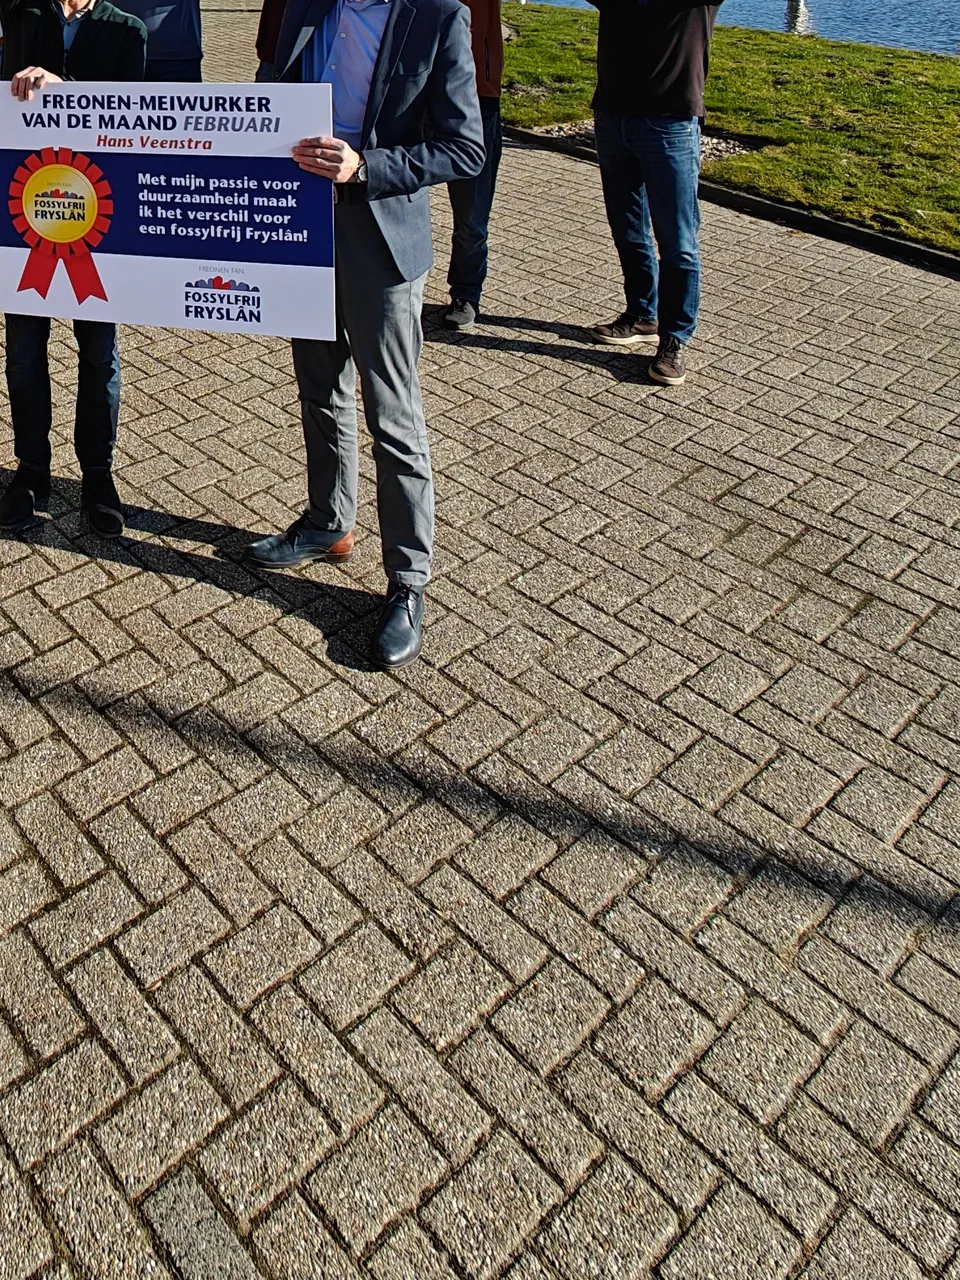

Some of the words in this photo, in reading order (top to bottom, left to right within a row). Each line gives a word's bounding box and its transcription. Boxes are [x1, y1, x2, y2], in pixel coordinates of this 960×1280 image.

[42, 94, 271, 113] FREONEN-MEIWURKER
[21, 112, 61, 129] VAN
[67, 114, 92, 129] DE
[99, 114, 177, 131] MAAND
[183, 115, 281, 133] FEBRUARI
[96, 134, 133, 148] Hans
[139, 135, 213, 150] Veenstra
[138, 173, 166, 186] Met
[171, 174, 205, 190] mijn
[209, 176, 258, 191] passie
[263, 179, 300, 190] voor
[34, 199, 85, 211] FOSSYLFRIJ
[138, 189, 249, 206] duurzaamheid
[253, 195, 297, 207] maak
[139, 205, 153, 218] ik
[157, 206, 183, 219] het
[187, 209, 249, 222] verschil
[253, 213, 291, 224] voor
[139, 224, 166, 235] een
[170, 223, 241, 243] fossylfrij
[245, 227, 308, 244] Fryslân!
[184, 291, 261, 309] FOSSYLFRIJ
[184, 305, 261, 323] FRYSLÂN
